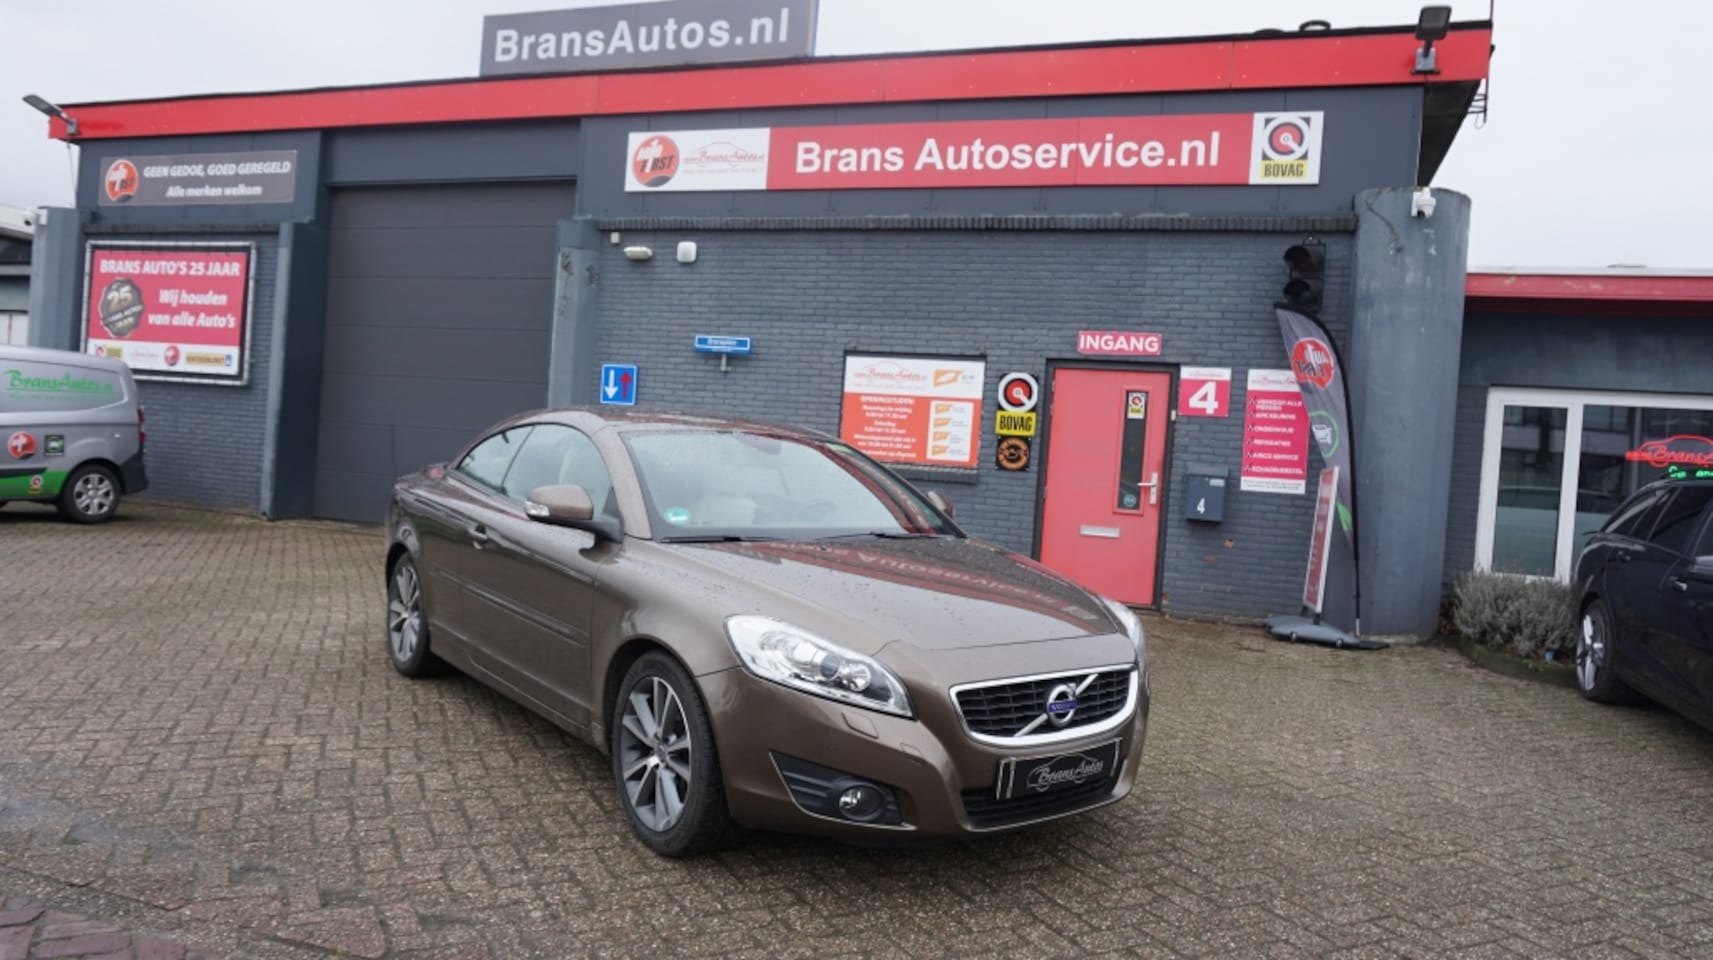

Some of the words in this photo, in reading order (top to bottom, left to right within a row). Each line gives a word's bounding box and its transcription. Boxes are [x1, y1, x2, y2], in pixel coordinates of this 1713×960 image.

[494, 7, 790, 63] BransAutos.nl
[795, 140, 904, 174] Brans
[914, 131, 1220, 172] Autoservice.nl
[143, 166, 170, 178] GEEN
[170, 164, 205, 177] GEDOE,
[207, 163, 236, 176] GOED
[237, 161, 291, 175] GEREGELD
[1263, 162, 1305, 178] BOVAG
[166, 185, 186, 198] Alle
[186, 185, 223, 197] merken
[224, 183, 262, 196] welkom
[100, 259, 141, 274] BRANS
[142, 260, 186, 275] AUTO'S
[189, 262, 205, 276] 25
[206, 262, 240, 276] JAAR
[159, 289, 178, 307] Wij
[180, 289, 227, 305] houden
[148, 313, 170, 325] van
[172, 312, 195, 326] alle
[196, 312, 236, 328] Auto's
[1079, 334, 1159, 352] INGANG
[1188, 381, 1219, 415] 4
[1000, 414, 1033, 432] BOVAG
[1196, 497, 1206, 515] 4
